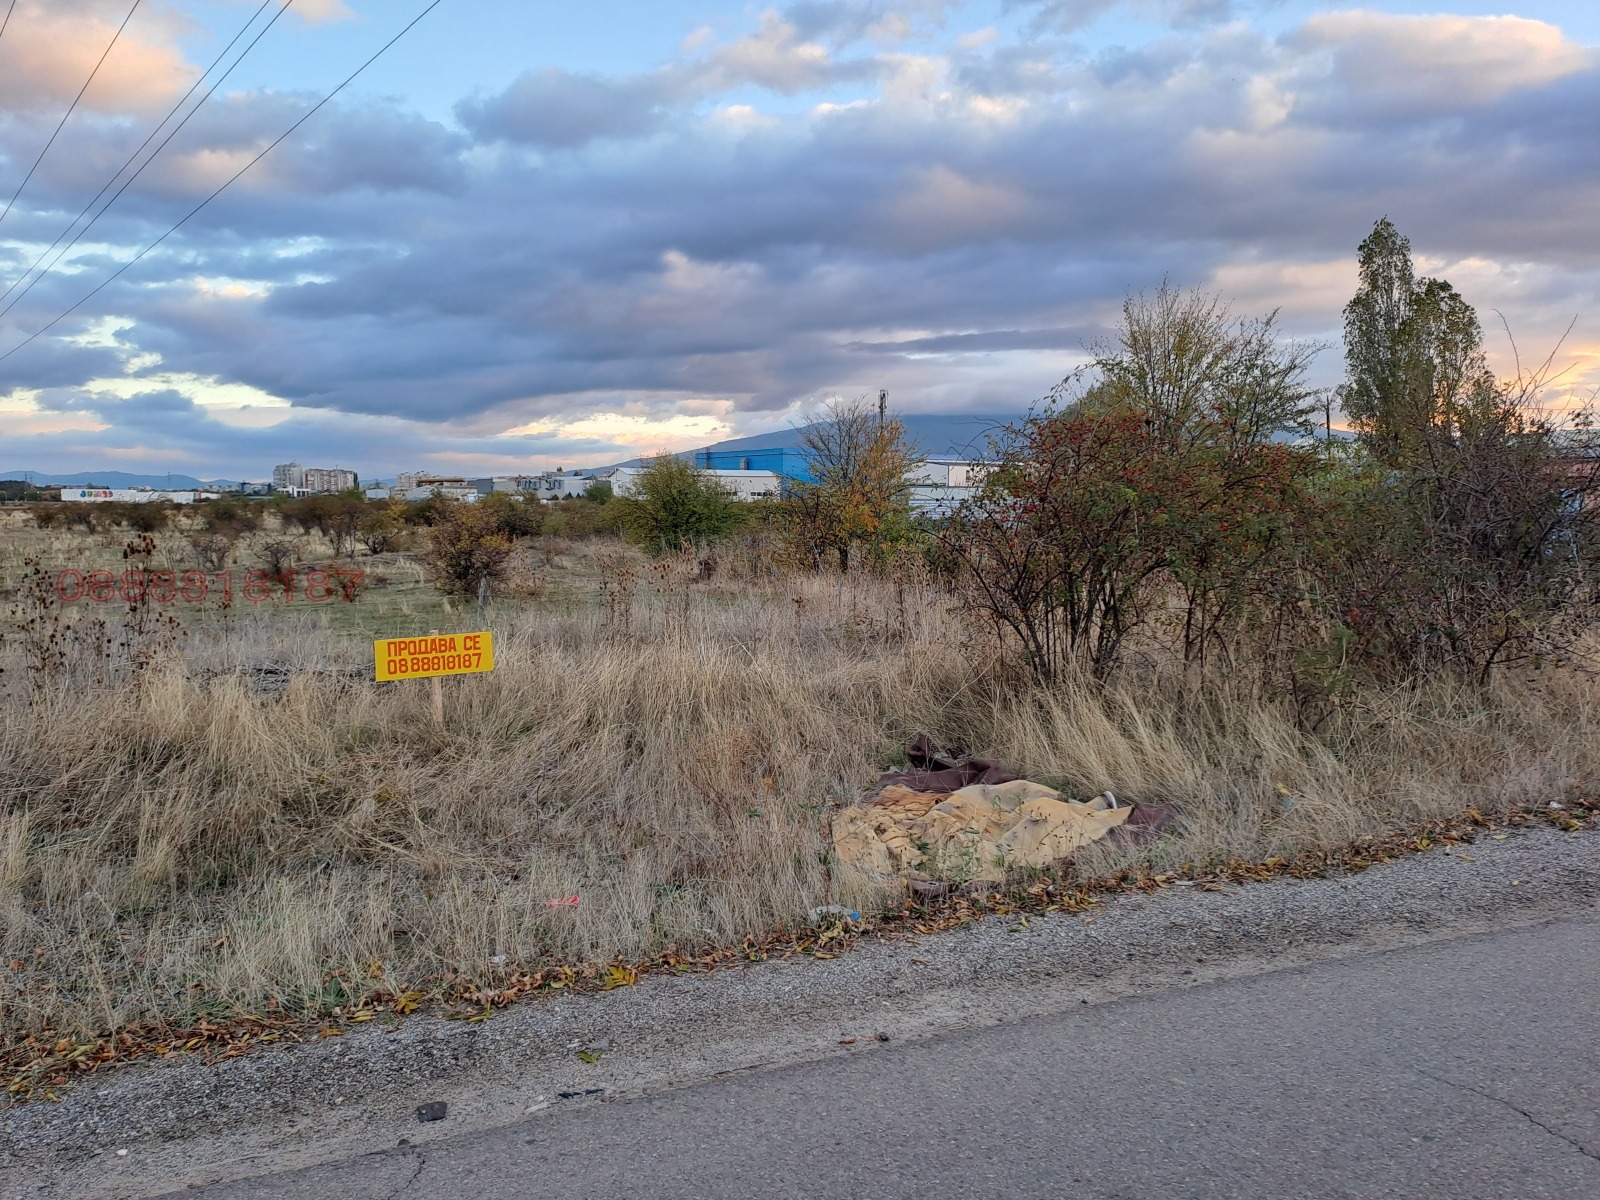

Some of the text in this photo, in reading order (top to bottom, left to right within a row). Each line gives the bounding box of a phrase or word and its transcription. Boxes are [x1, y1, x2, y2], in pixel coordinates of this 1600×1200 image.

[387, 635, 481, 657] ПРОДАВА СЕ
[387, 653, 482, 675] 0888818187
